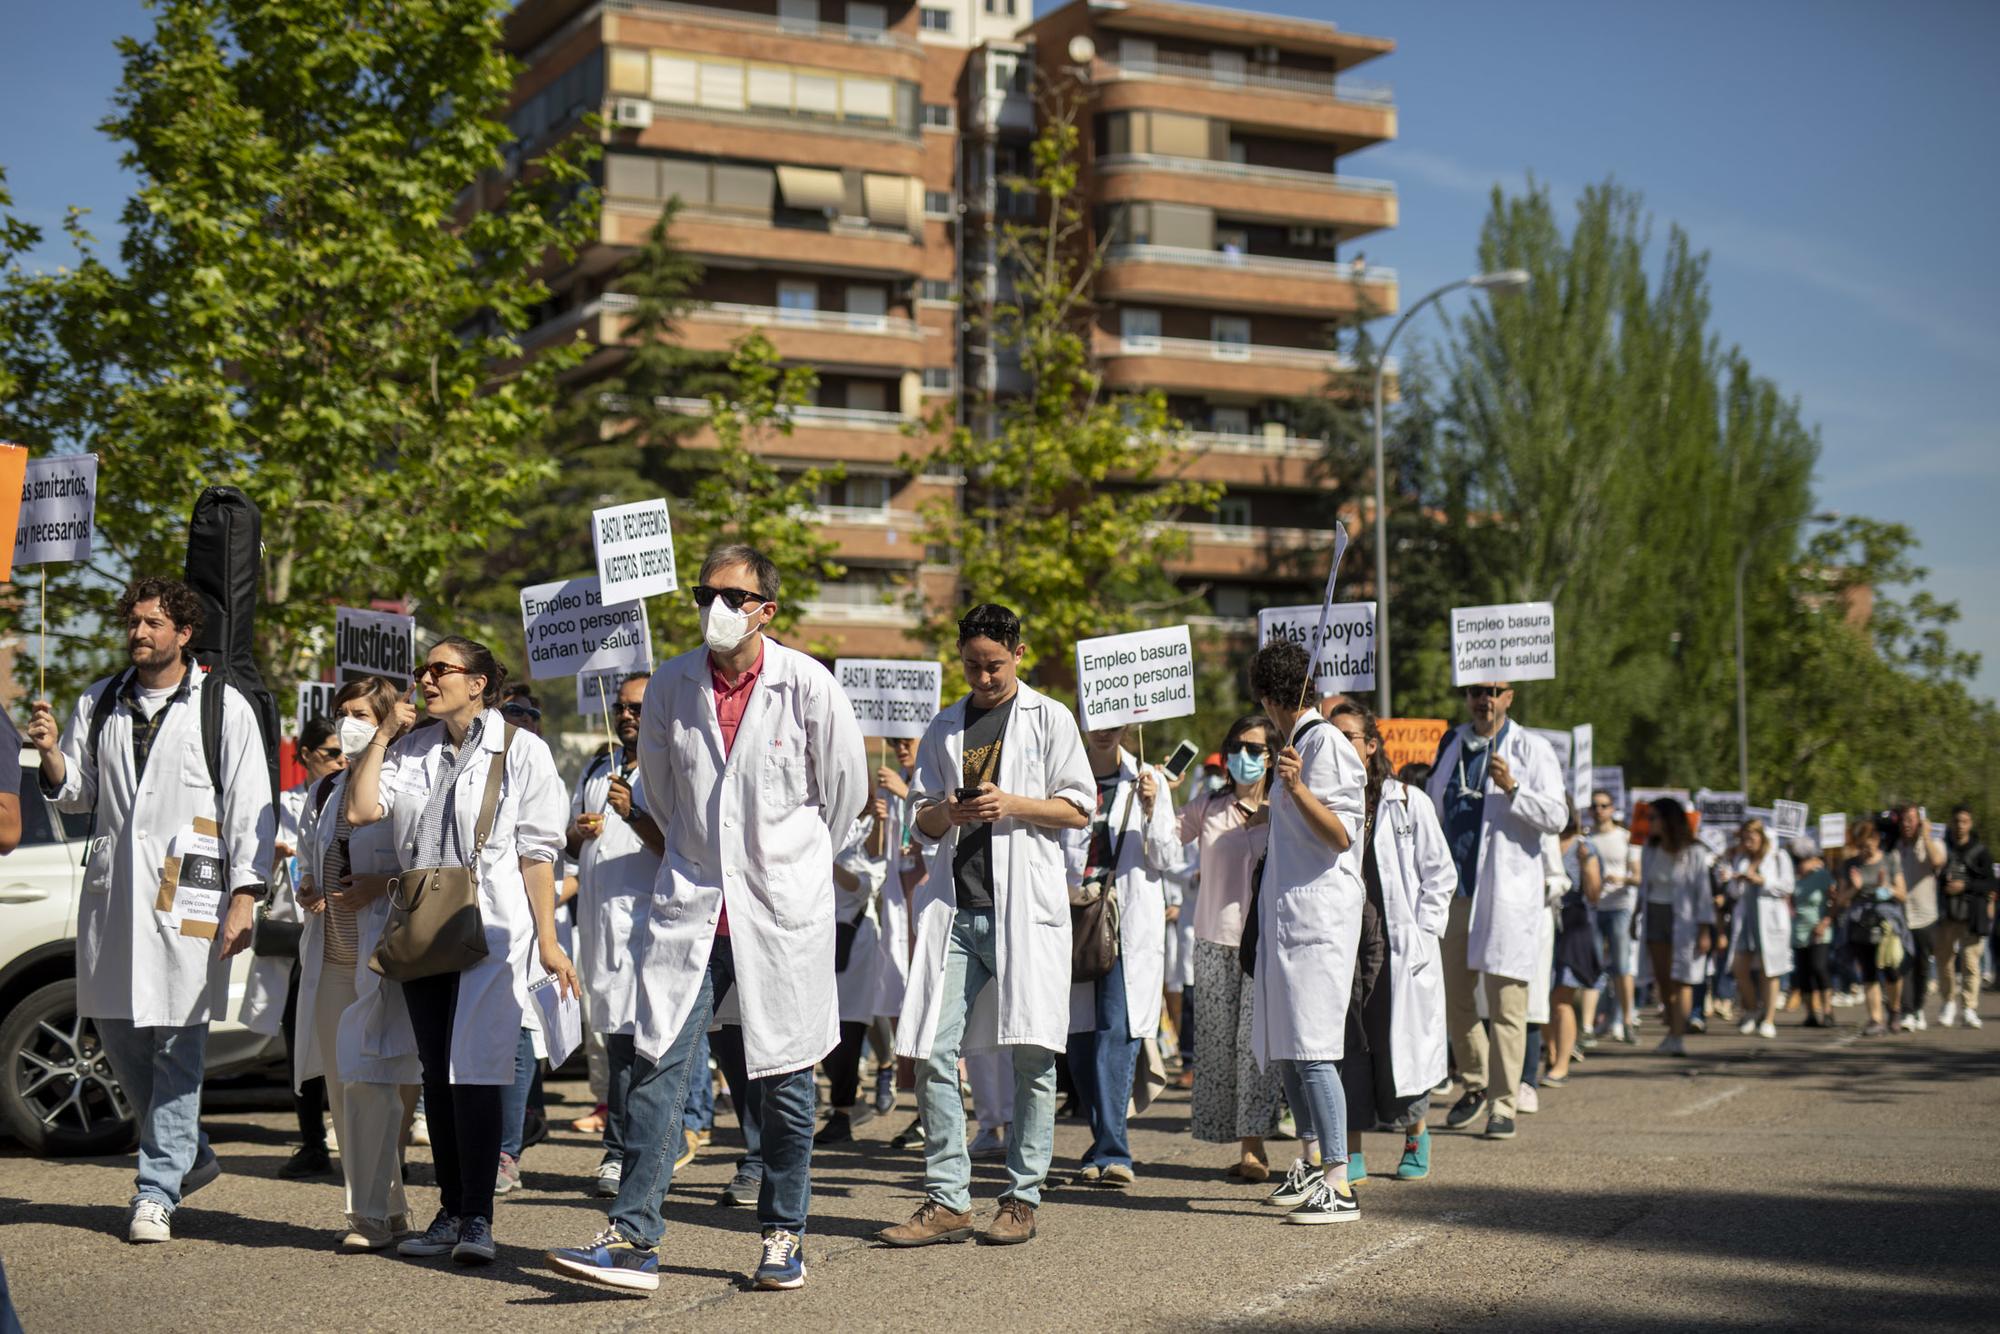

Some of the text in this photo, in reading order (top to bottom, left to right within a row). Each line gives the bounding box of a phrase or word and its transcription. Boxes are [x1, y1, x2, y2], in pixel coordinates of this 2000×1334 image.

[34, 470, 88, 500] sanitarios,
[15, 512, 90, 553] uy necesarios!
[623, 509, 667, 543] RECUPEREMOS
[604, 553, 638, 584] NUESTROS
[525, 590, 601, 616] Empleo ba
[527, 605, 643, 643] y poco personal
[1457, 615, 1550, 634] Empleo basura
[336, 617, 412, 676] ¡Justicia!
[531, 629, 644, 662] dañan tu salud.
[1084, 643, 1187, 671] Empleo basura
[1457, 632, 1553, 656] y poco personal
[1313, 652, 1374, 678] anidad!
[1459, 651, 1552, 671] dañan tu salud.
[876, 668, 934, 691] RECUPEREMOS
[1084, 661, 1191, 698] y poco personal
[1088, 684, 1191, 716] dañan tu salud.
[1384, 728, 1442, 743] AYUSO
